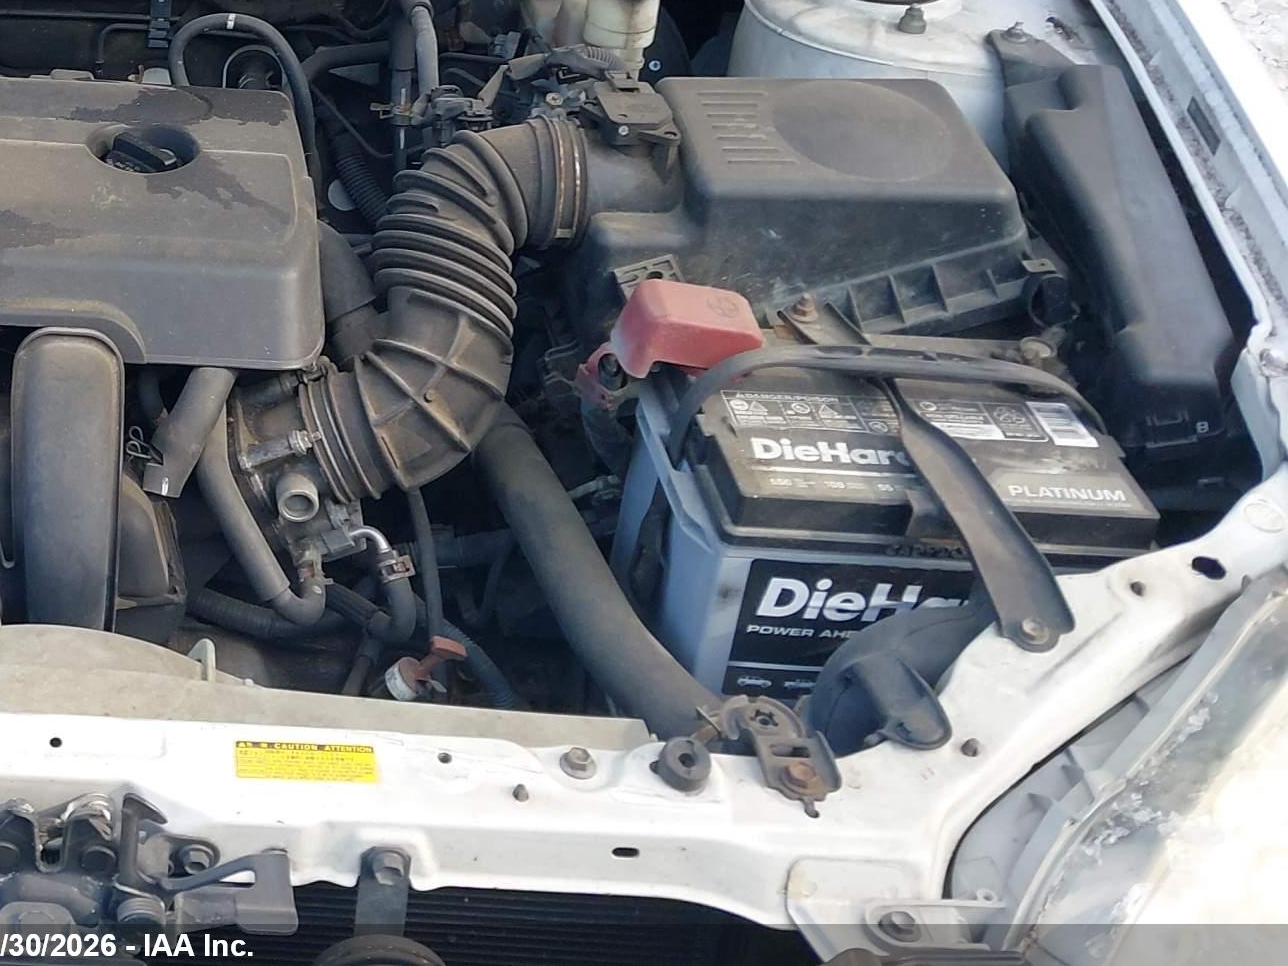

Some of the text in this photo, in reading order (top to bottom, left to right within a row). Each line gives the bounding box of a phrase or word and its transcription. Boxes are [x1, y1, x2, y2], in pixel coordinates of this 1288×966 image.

[1008, 485, 1126, 501] PLATINUM
[747, 624, 814, 638] POWER
[274, 743, 318, 751] CAUTION
[324, 744, 372, 753] ATTENTION
